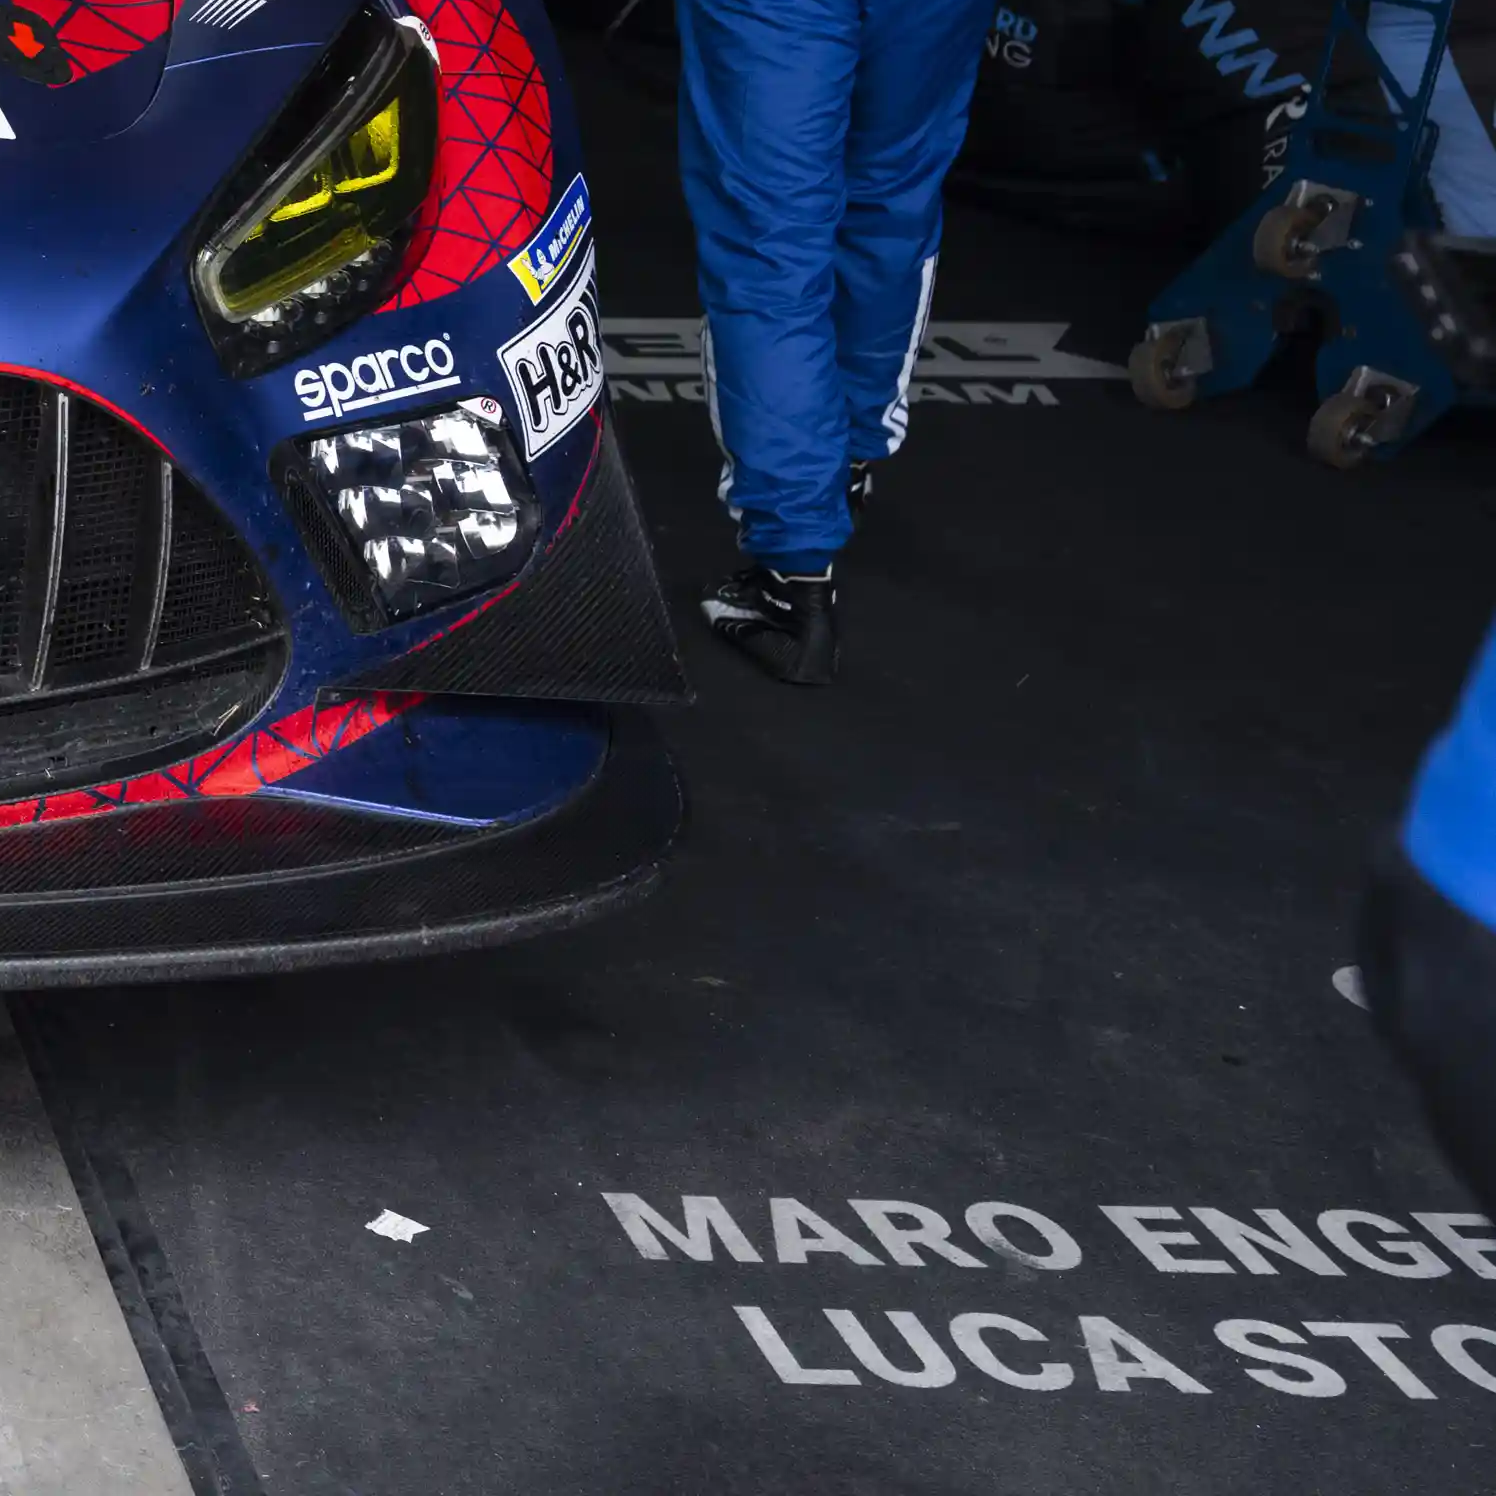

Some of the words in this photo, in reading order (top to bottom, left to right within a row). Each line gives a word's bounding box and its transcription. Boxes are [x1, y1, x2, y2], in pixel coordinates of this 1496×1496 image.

[547, 194, 587, 263] MICHELIN
[516, 304, 599, 431] H&R
[600, 1191, 1085, 1272] MARO
[731, 1303, 1213, 1396] LUCA
